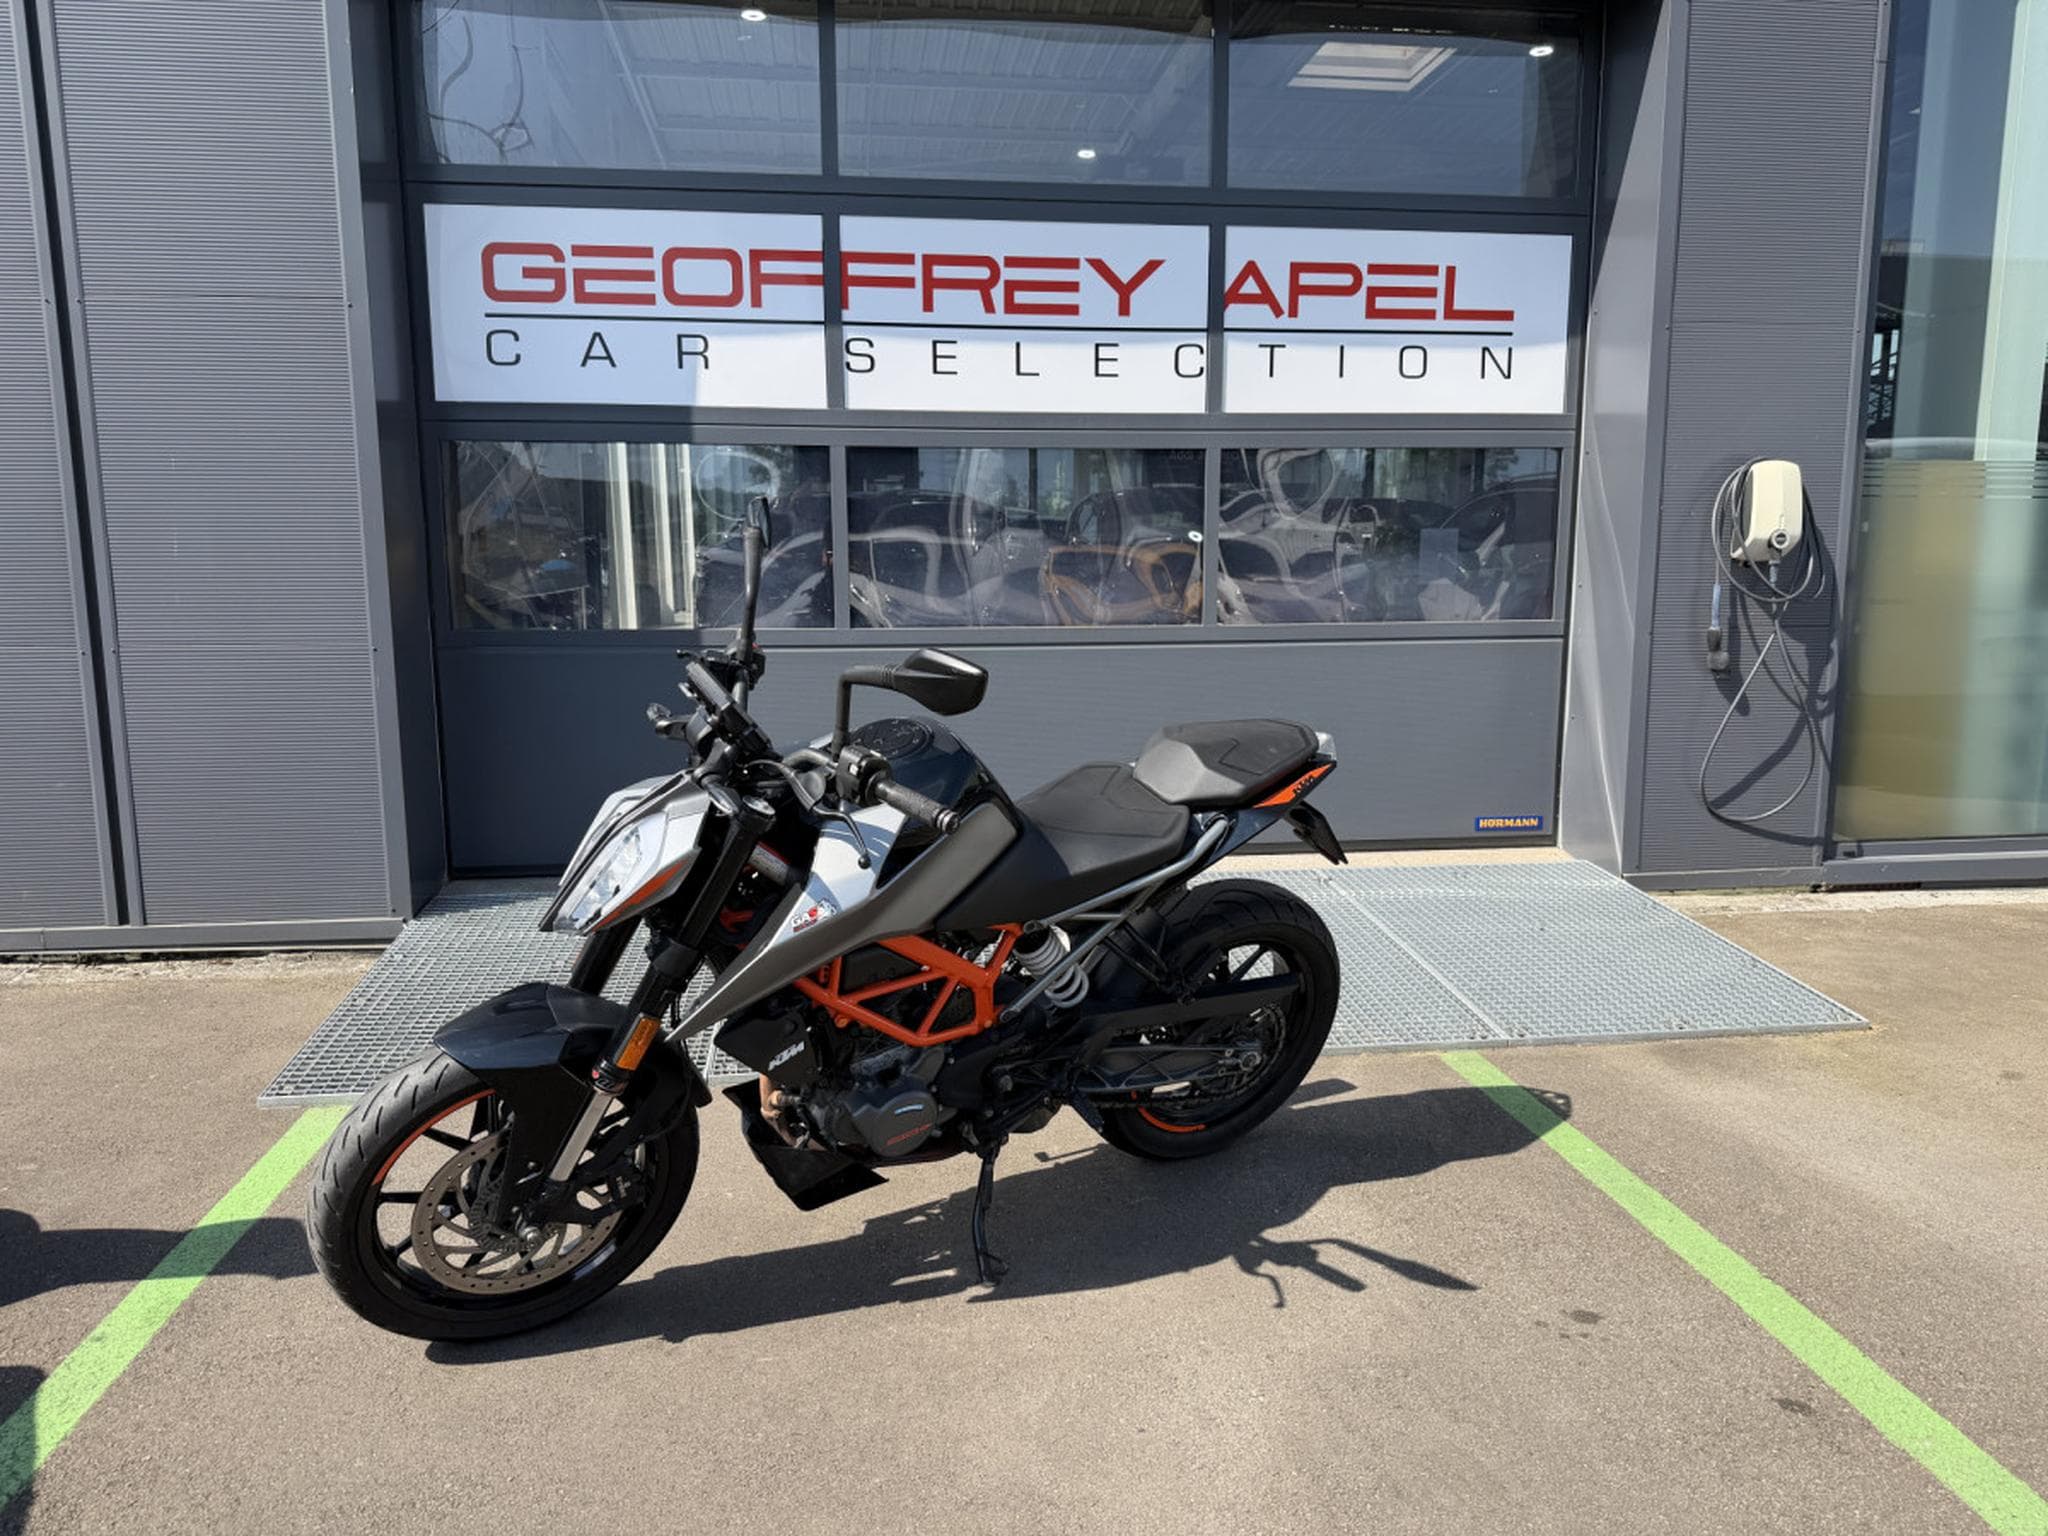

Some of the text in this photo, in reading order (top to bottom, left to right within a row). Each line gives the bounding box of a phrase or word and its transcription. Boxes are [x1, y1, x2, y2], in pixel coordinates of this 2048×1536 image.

[481, 242, 1514, 321] GEOFFREY APEL
[485, 329, 1514, 380] CAR SELECTION
